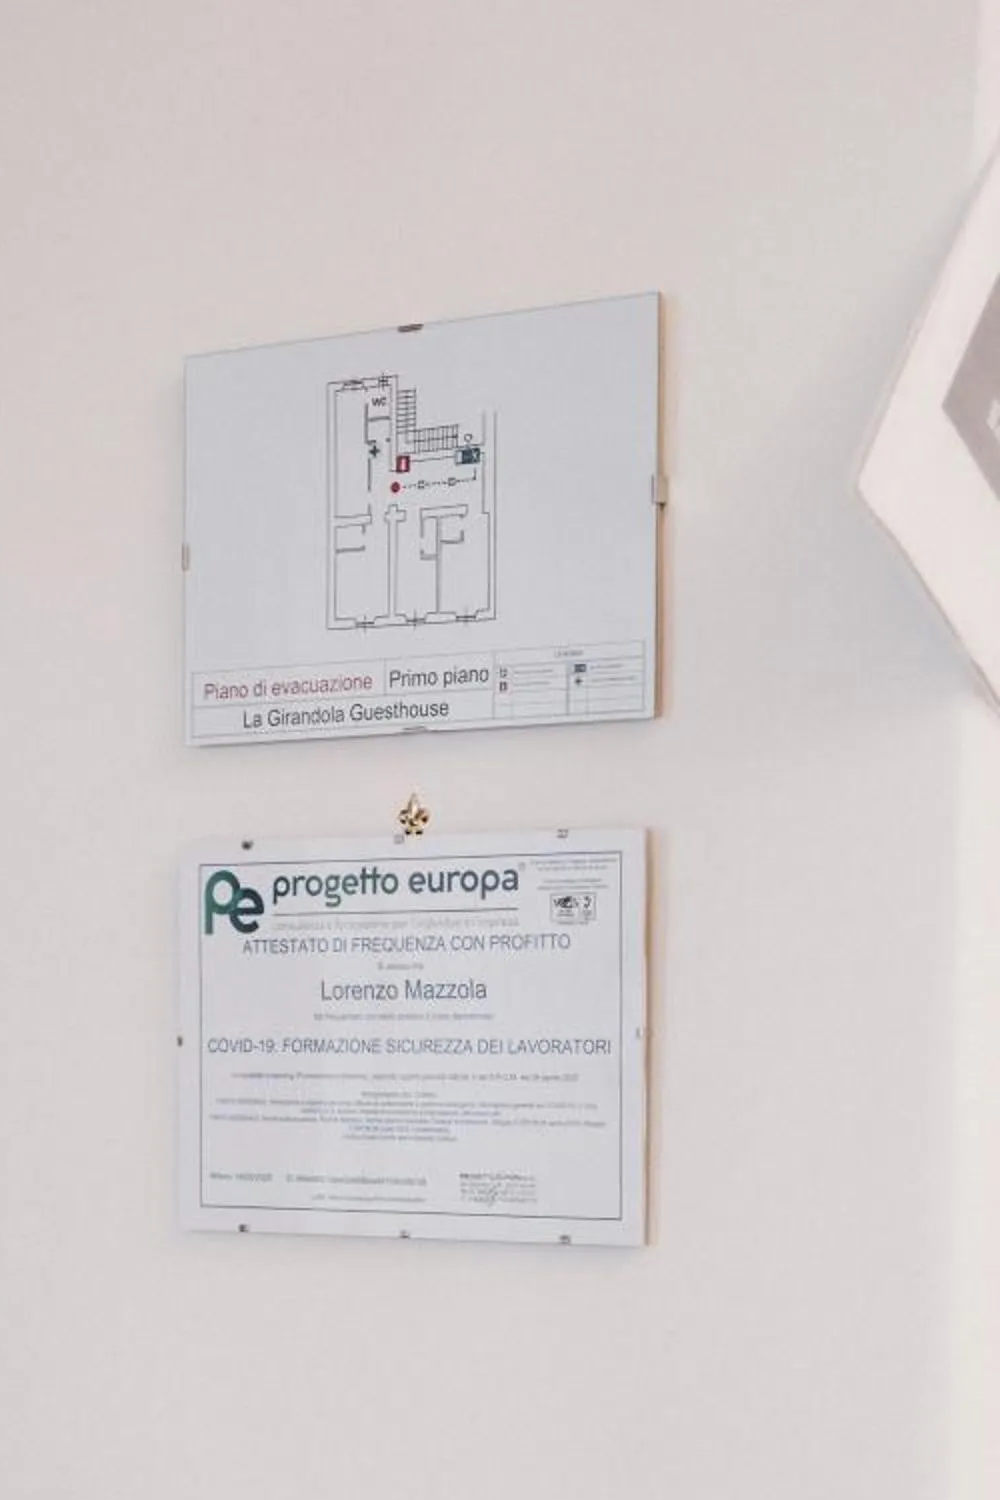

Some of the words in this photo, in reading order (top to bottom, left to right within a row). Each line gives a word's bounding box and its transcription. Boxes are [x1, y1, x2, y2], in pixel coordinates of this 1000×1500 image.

[371, 396, 387, 407] WC
[204, 683, 249, 700] Piano
[253, 679, 267, 697] di
[271, 674, 373, 697] evacuazione
[389, 668, 438, 689] Primo
[443, 665, 489, 688] piano
[243, 710, 263, 729] La
[267, 705, 345, 727] Girandola
[349, 700, 449, 722] Guesthouse
[273, 866, 399, 908] progetto
[408, 868, 519, 900] europa
[243, 938, 329, 954] ATTESTATO
[333, 938, 347, 953] DI
[351, 935, 445, 953] FREQUENZA
[451, 935, 485, 951] CON
[489, 932, 571, 950] PROFITTO
[321, 978, 399, 1001] Lorenzo
[404, 977, 487, 1001] Mazzola
[282, 1037, 381, 1054] FORMAZIONE
[385, 1037, 473, 1055] SICUREZZA
[477, 1038, 503, 1055] DEI
[507, 1038, 611, 1056] LAVORATORI
